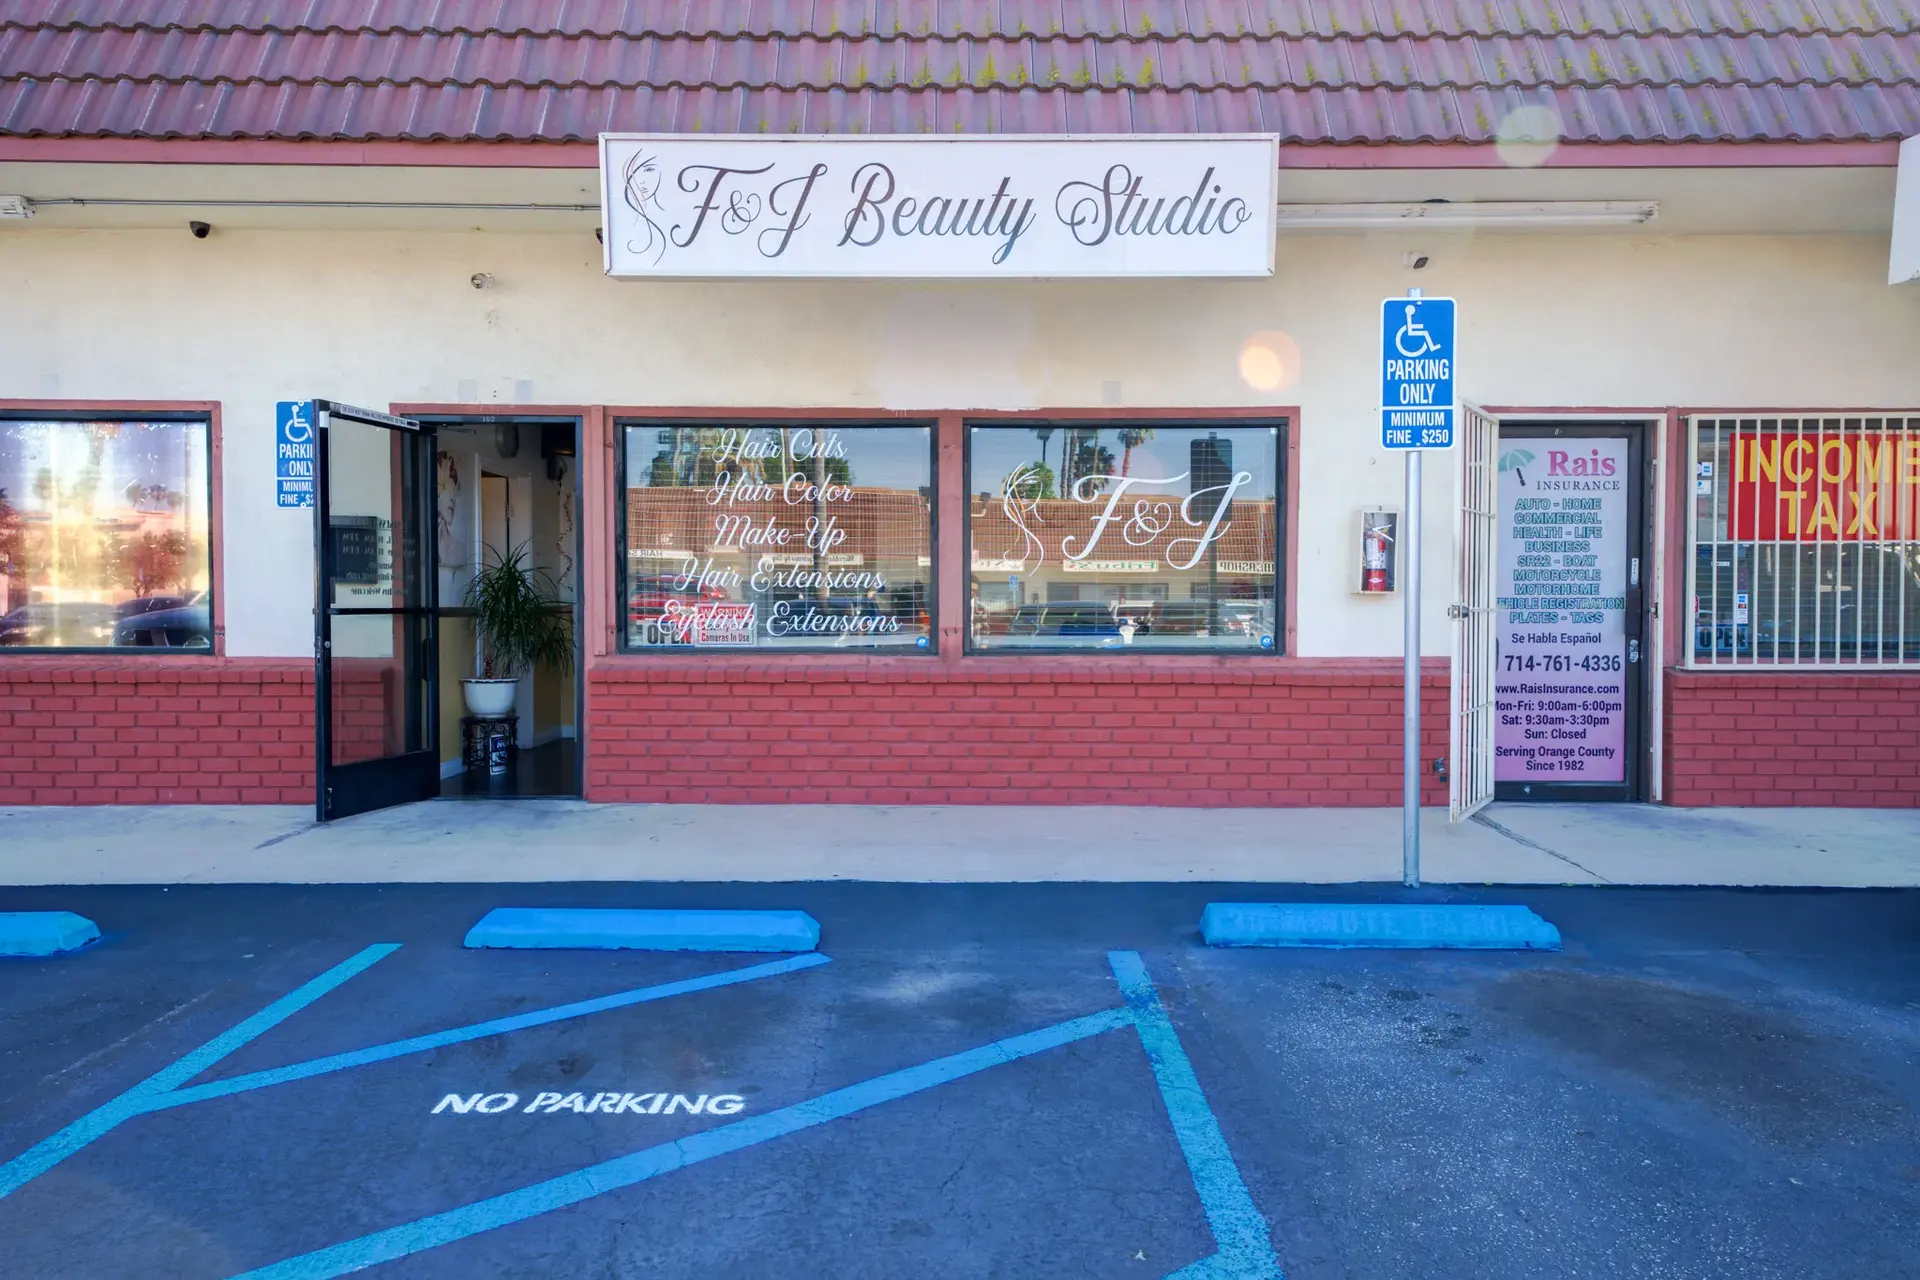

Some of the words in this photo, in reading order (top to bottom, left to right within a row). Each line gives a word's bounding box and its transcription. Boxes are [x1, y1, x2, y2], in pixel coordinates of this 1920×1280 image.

[671, 162, 828, 258] F&J
[837, 162, 1036, 265] Beauty
[1056, 164, 1252, 247] Studio
[1387, 359, 1449, 380] PARKING
[1400, 383, 1436, 404] ONLY
[1391, 412, 1445, 426] MINIMUM
[1386, 430, 1412, 444] FINE
[1421, 429, 1449, 445] $250
[279, 443, 313, 459] PARKI
[712, 428, 783, 464] Hair
[789, 428, 848, 462] Cuts
[289, 460, 313, 476] ONLY
[1547, 449, 1616, 477] Rais
[1738, 439, 1920, 484] INCOME
[282, 481, 313, 492] MINIMU
[706, 471, 776, 507] Hair
[783, 472, 855, 505] Color
[1537, 480, 1621, 491] INSURANCE
[280, 493, 298, 504] FINE
[1515, 498, 1551, 511] AUTO
[1562, 498, 1602, 511] HOME
[1514, 512, 1602, 524] COMMERCIAL
[1779, 490, 1879, 535] TAX
[1062, 471, 1252, 570] F&J
[713, 514, 848, 556] Make-Up
[1513, 527, 1563, 538] HEALTH
[1574, 527, 1602, 538] LIFE
[1525, 541, 1590, 552] BUSINESS
[1517, 555, 1552, 567] SR22
[1563, 555, 1598, 567] BOAT
[674, 557, 743, 593] Hair
[750, 557, 887, 592] Extensions
[1513, 570, 1601, 581] MOTORCYCLE
[1514, 583, 1600, 595] MOTORHOME
[1541, 597, 1625, 609] REGISTRATION
[657, 600, 759, 641] Eyelash
[766, 600, 903, 636] Extensions
[1510, 612, 1558, 624] PLATES
[1570, 612, 1604, 624] TAGS
[701, 633, 729, 642] Cameras
[730, 633, 737, 642] In
[738, 633, 750, 642] Use
[1511, 633, 1525, 644] Se
[1527, 633, 1557, 644] Habla
[1560, 632, 1601, 646] Español
[1504, 655, 1621, 672] 714-761-4336
[1538, 700, 1622, 713] 9:00am-6:00pm
[1501, 715, 1523, 726] Sat:
[1525, 715, 1610, 727] 9:30am-3:30pm
[1524, 729, 1548, 739] Sun:
[1551, 728, 1587, 739] Closed
[1495, 746, 1535, 759] Serving
[1538, 746, 1575, 759] Orange
[1578, 746, 1615, 759] County
[1526, 760, 1555, 771] Since
[1558, 760, 1584, 771] 1982
[430, 1093, 520, 1114] NO
[523, 1092, 745, 1115] PARKING
